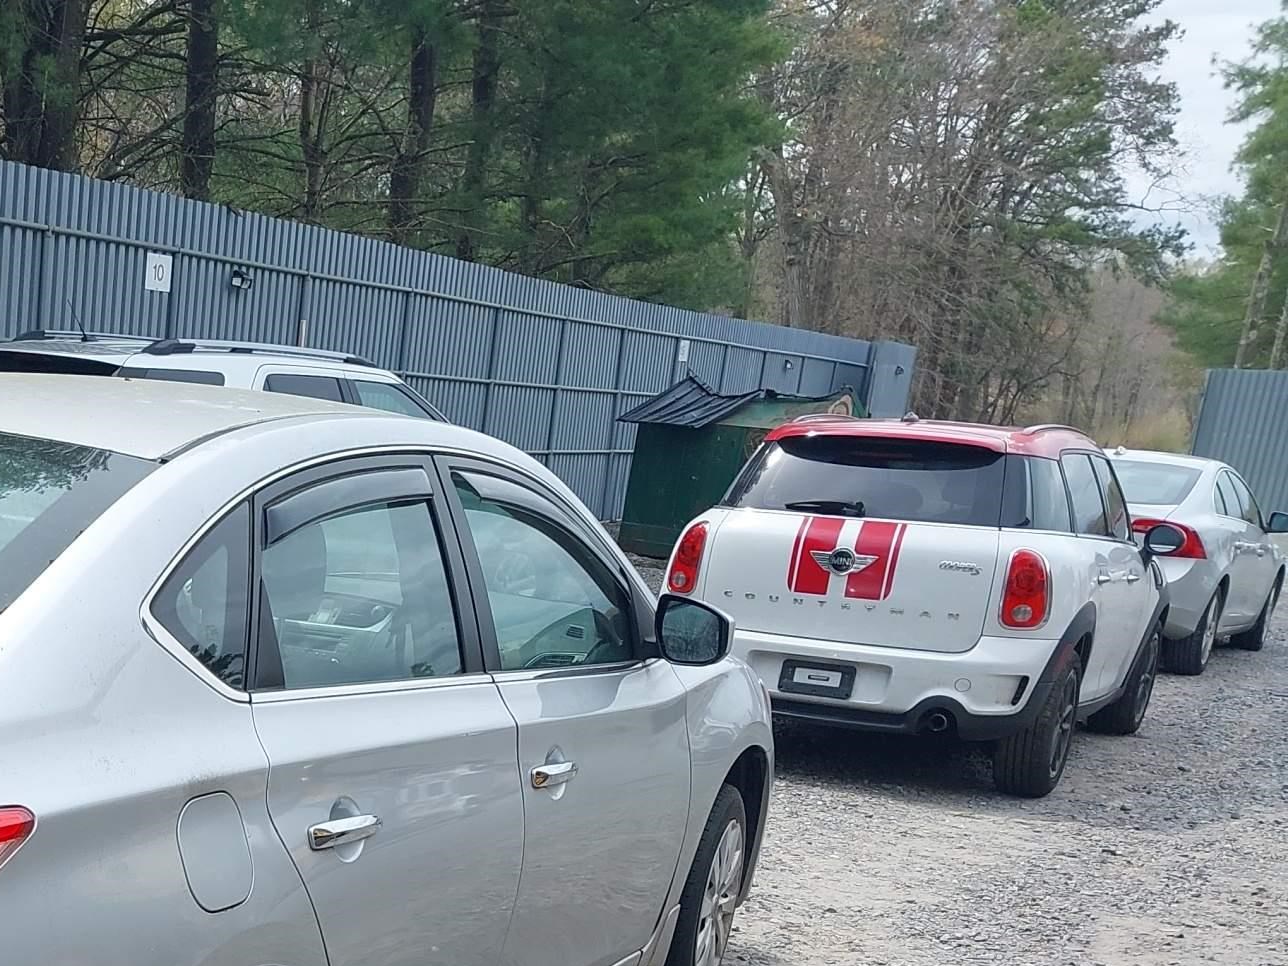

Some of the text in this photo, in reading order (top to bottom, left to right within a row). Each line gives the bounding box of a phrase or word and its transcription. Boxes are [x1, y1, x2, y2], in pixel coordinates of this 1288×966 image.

[152, 263, 165, 282] 10
[831, 556, 852, 566] MINI
[723, 589, 961, 621] COUNTRYMAN
